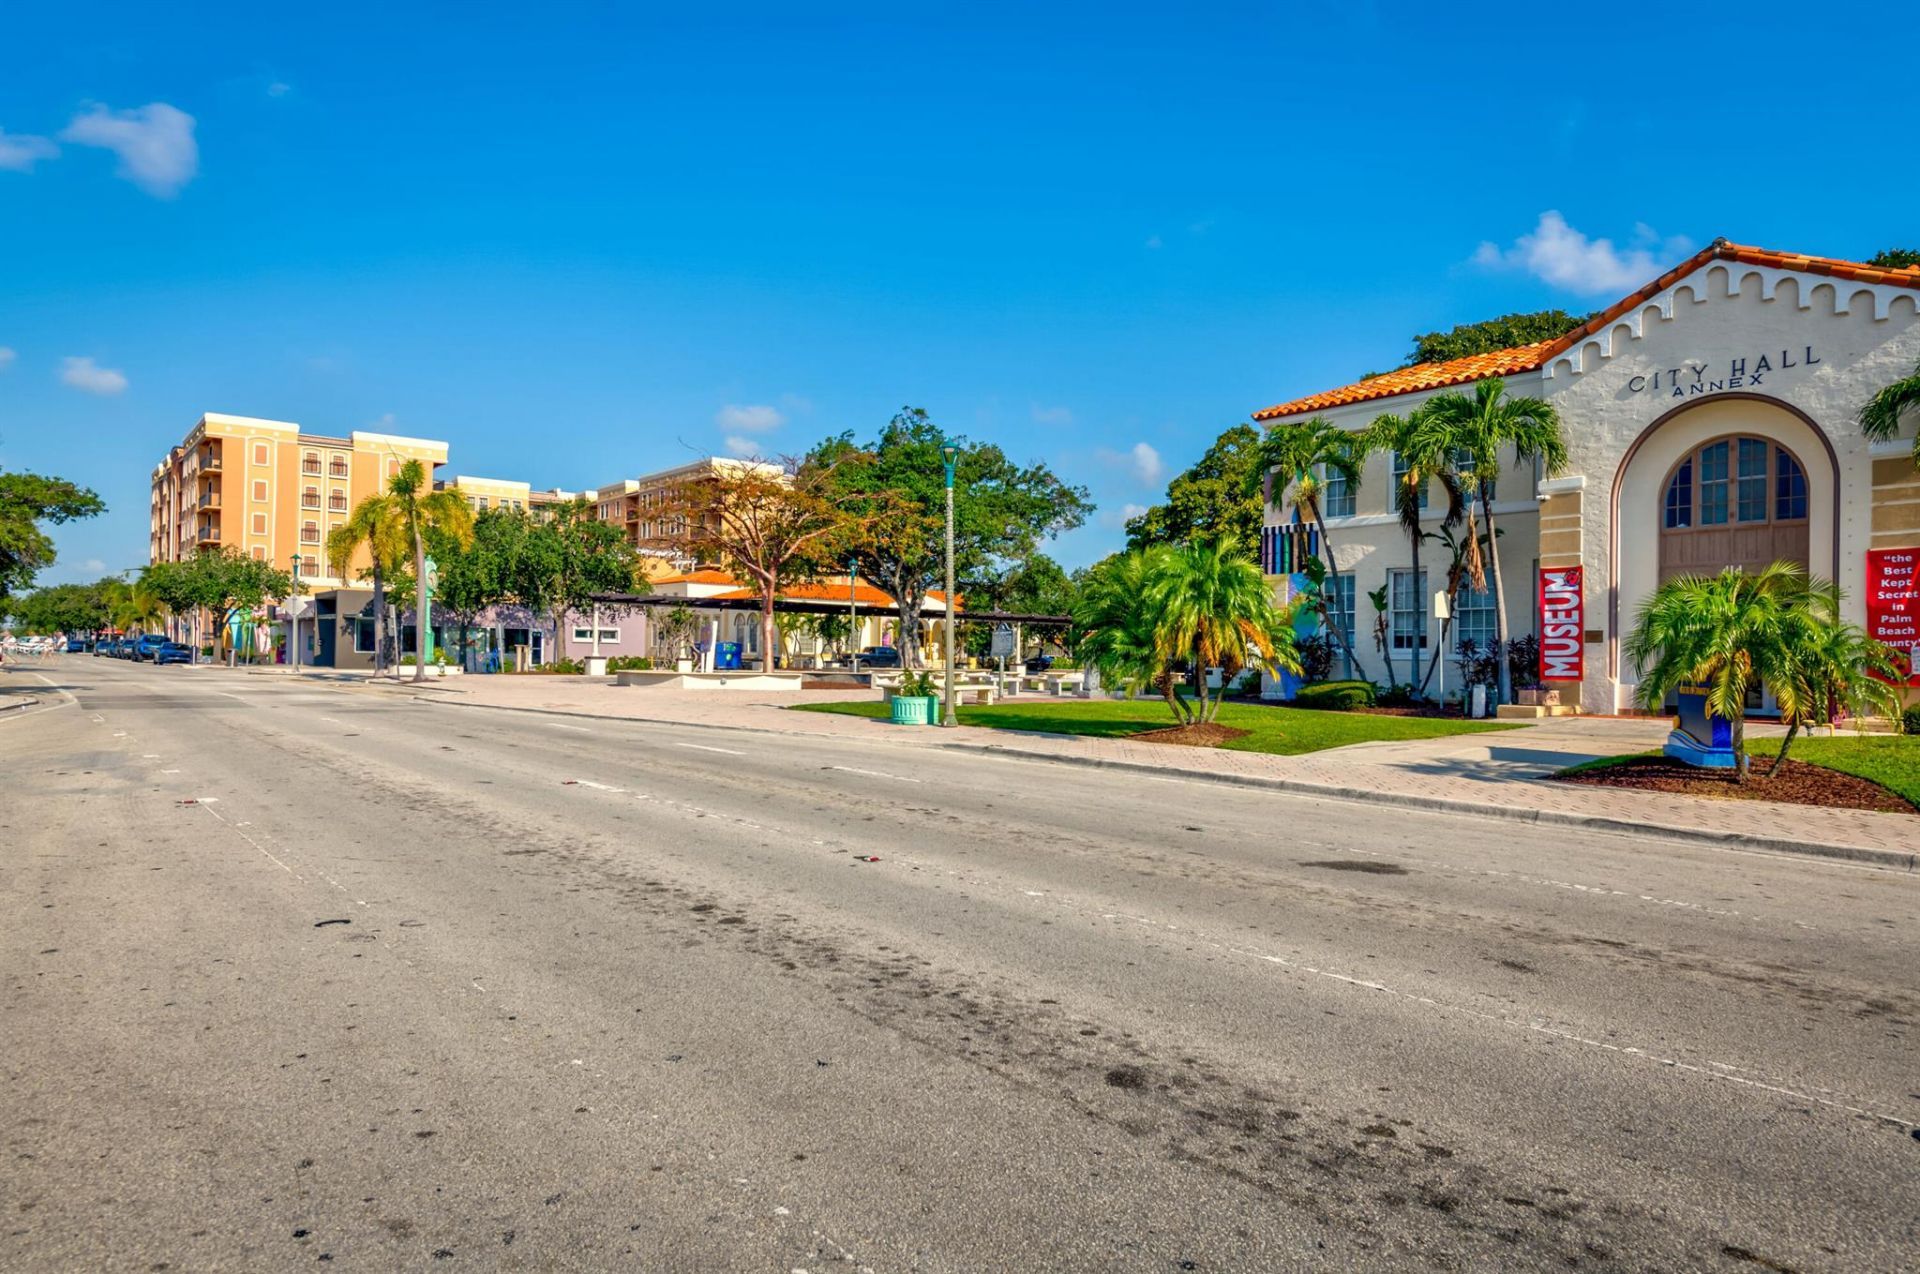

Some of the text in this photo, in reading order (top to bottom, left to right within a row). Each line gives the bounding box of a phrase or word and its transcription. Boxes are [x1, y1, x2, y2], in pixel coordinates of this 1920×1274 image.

[1629, 346, 1821, 392] CITY HALL
[1672, 373, 1764, 397] ANNEX
[1883, 567, 1912, 575] Best
[1881, 579, 1913, 588] Kept
[1878, 591, 1918, 599] Secret
[1893, 603, 1904, 611] in
[1881, 615, 1912, 623] Palm
[1544, 572, 1579, 676] MUSEUM
[1877, 627, 1915, 636] Beach
[1875, 639, 1920, 648] ounty
